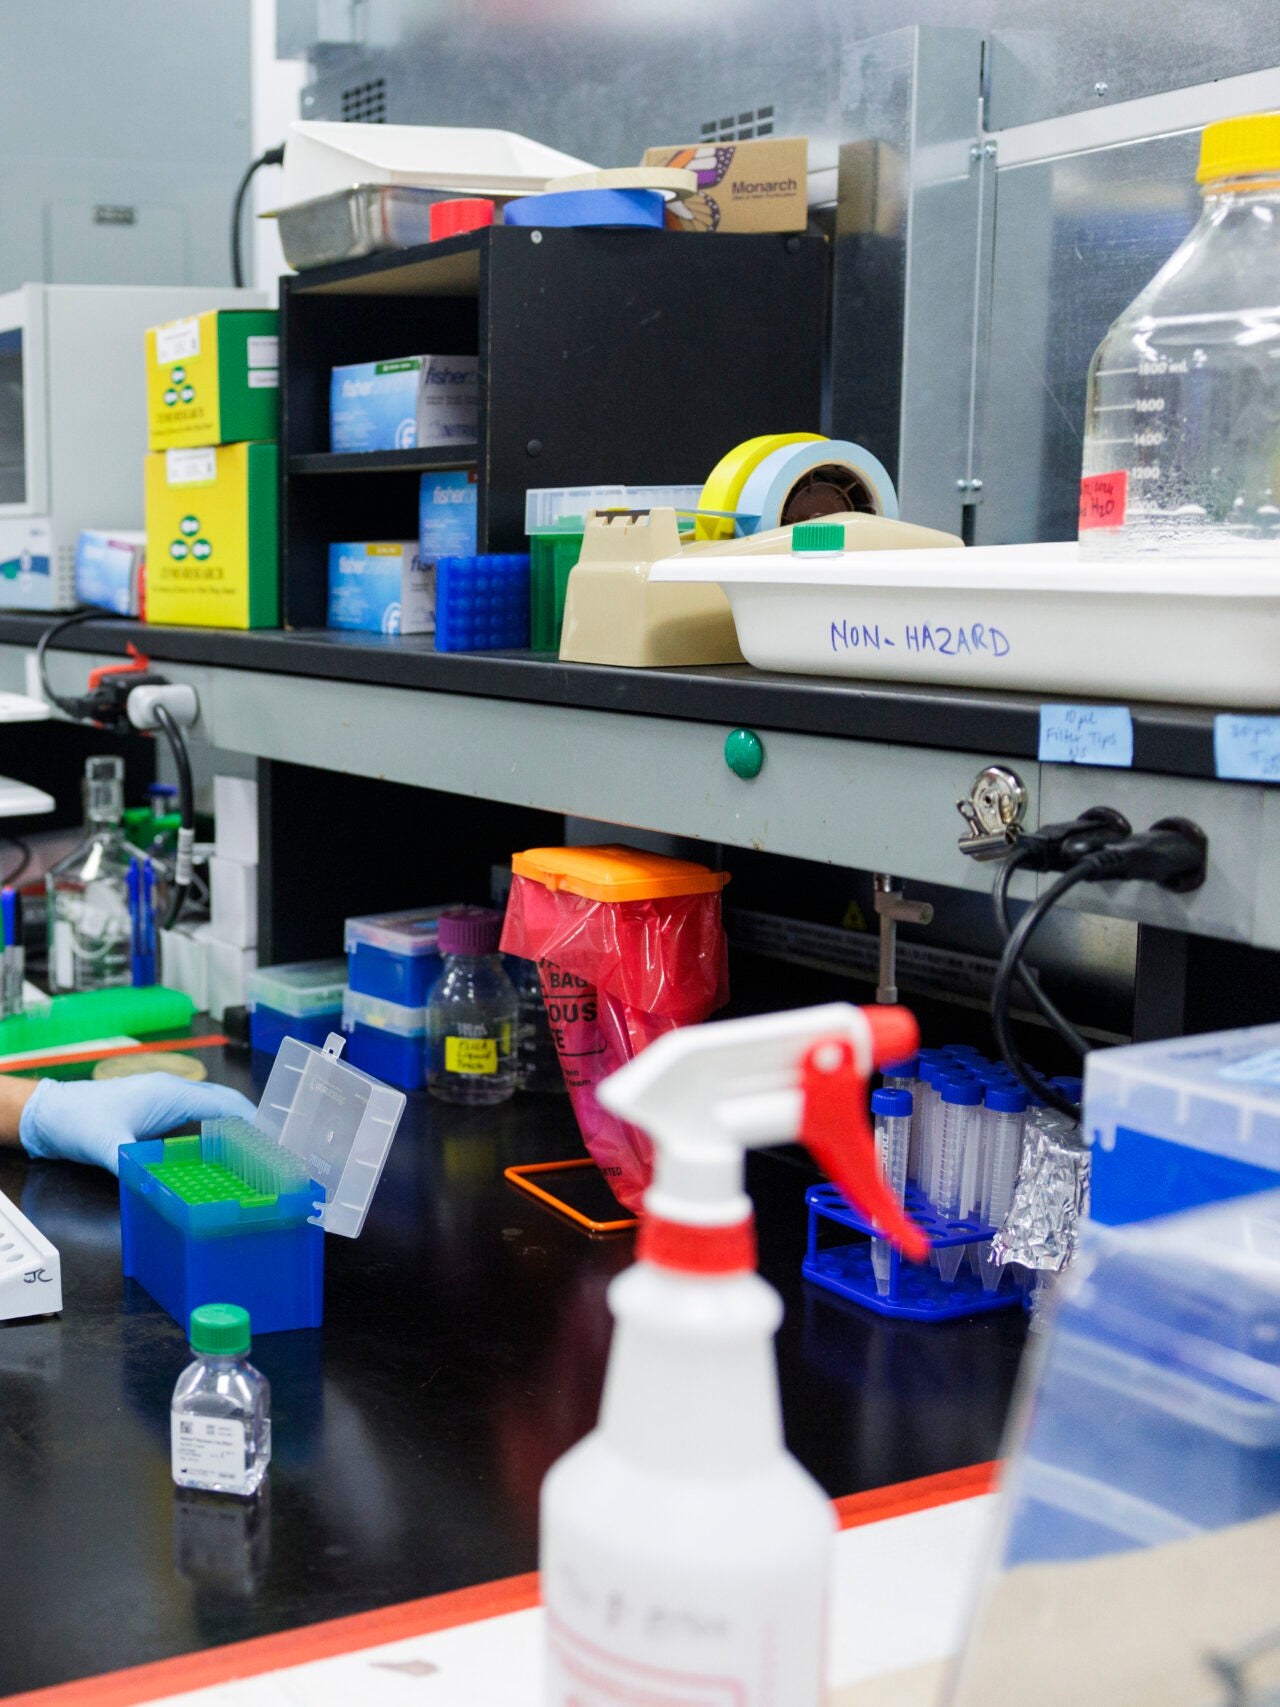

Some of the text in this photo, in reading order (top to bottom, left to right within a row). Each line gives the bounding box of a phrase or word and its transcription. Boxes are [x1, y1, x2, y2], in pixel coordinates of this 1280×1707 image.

[732, 178, 797, 193] Monarch
[1138, 362, 1167, 375] 1800
[1136, 398, 1164, 412] 1600
[1133, 433, 1162, 446] 1400
[1131, 467, 1160, 480] 1200
[905, 622, 1011, 657] HAZARD
